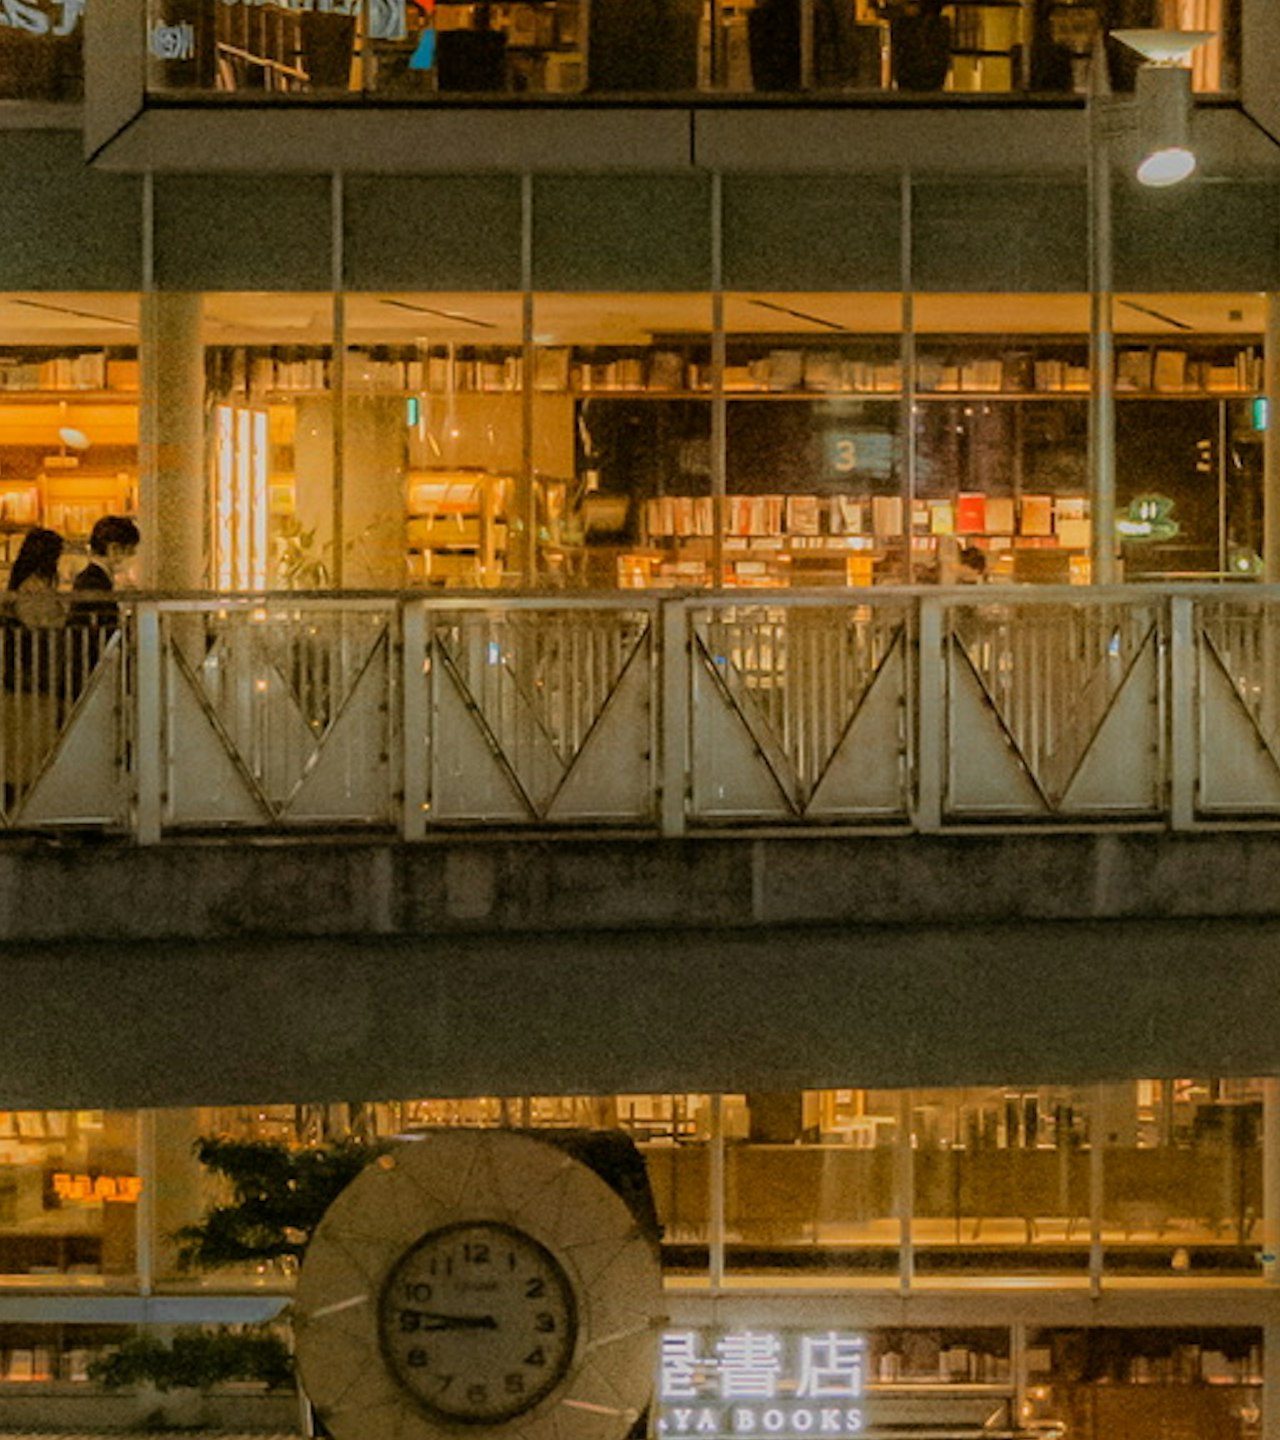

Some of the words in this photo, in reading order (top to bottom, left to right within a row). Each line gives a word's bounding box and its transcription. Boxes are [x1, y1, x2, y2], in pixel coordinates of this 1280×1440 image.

[834, 438, 857, 471] 3
[464, 1244, 490, 1263] 12
[405, 1283, 432, 1303] 10
[526, 1278, 545, 1298] 2
[523, 1345, 546, 1367] 4
[736, 1408, 863, 1431] BOOKS
